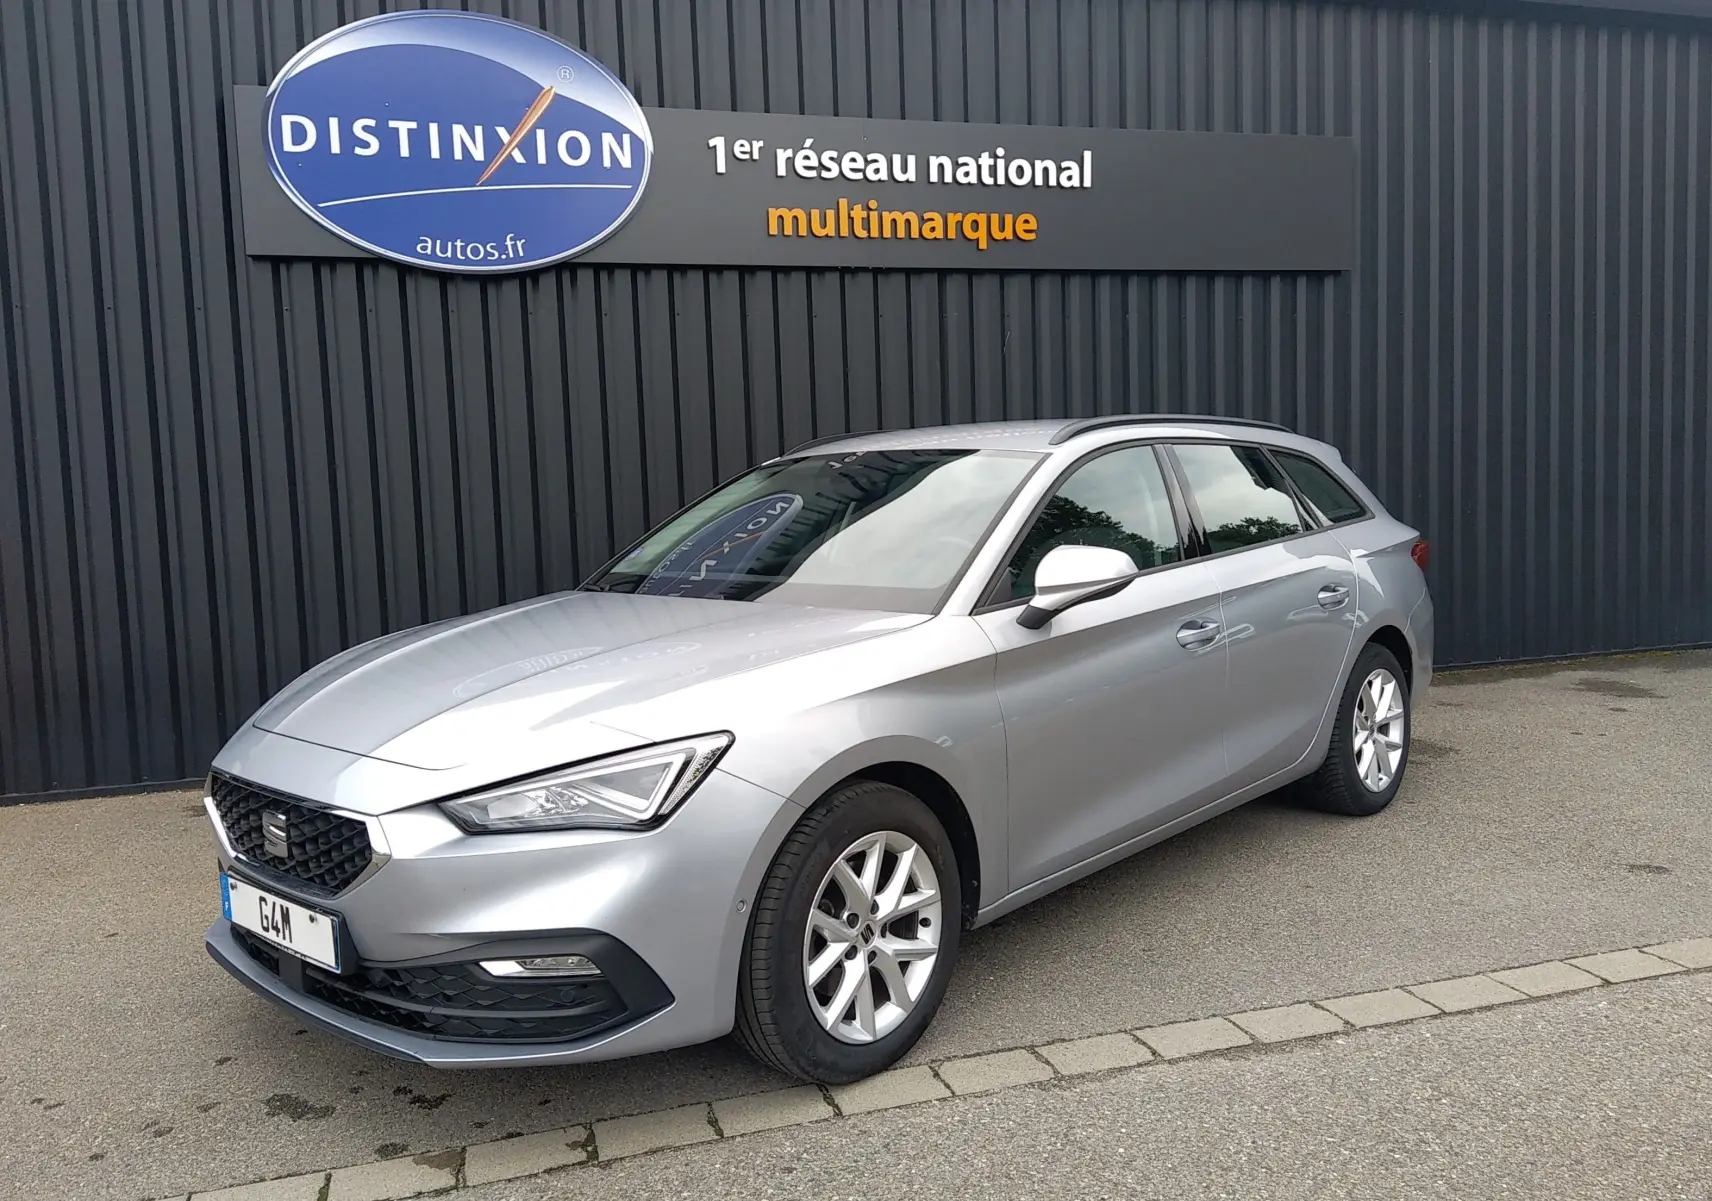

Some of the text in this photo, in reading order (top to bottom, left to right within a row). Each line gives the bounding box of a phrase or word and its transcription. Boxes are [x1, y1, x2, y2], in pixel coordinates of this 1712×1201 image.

[280, 113, 632, 169] DISTINXION
[707, 135, 1092, 188] 1er réseau national
[416, 233, 526, 261] autos.fr
[767, 198, 1039, 250] multimarque
[258, 895, 293, 944] G4M
